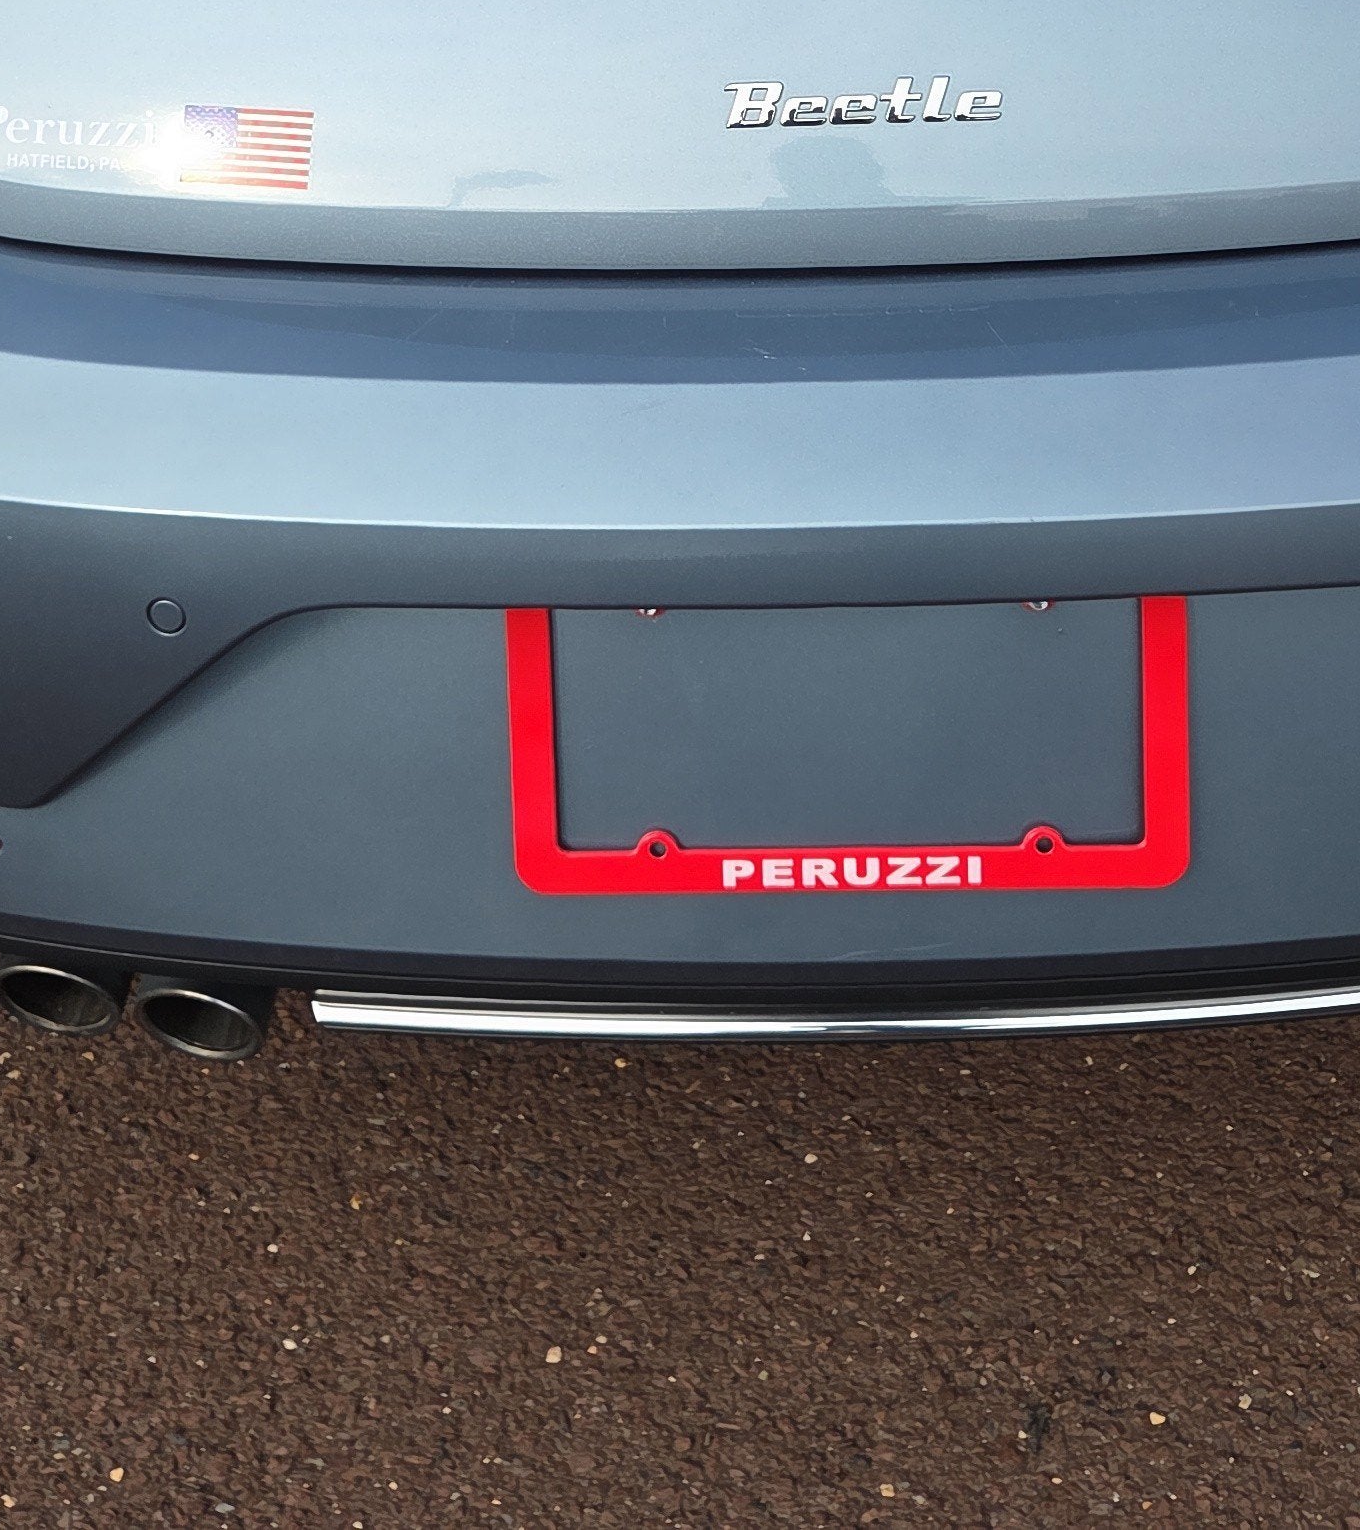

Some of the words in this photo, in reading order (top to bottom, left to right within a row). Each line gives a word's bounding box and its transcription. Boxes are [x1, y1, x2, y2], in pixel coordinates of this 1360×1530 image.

[723, 75, 1003, 129] Beetle
[6, 152, 96, 173] HATFIELD,
[722, 855, 983, 889] PERUZZI
